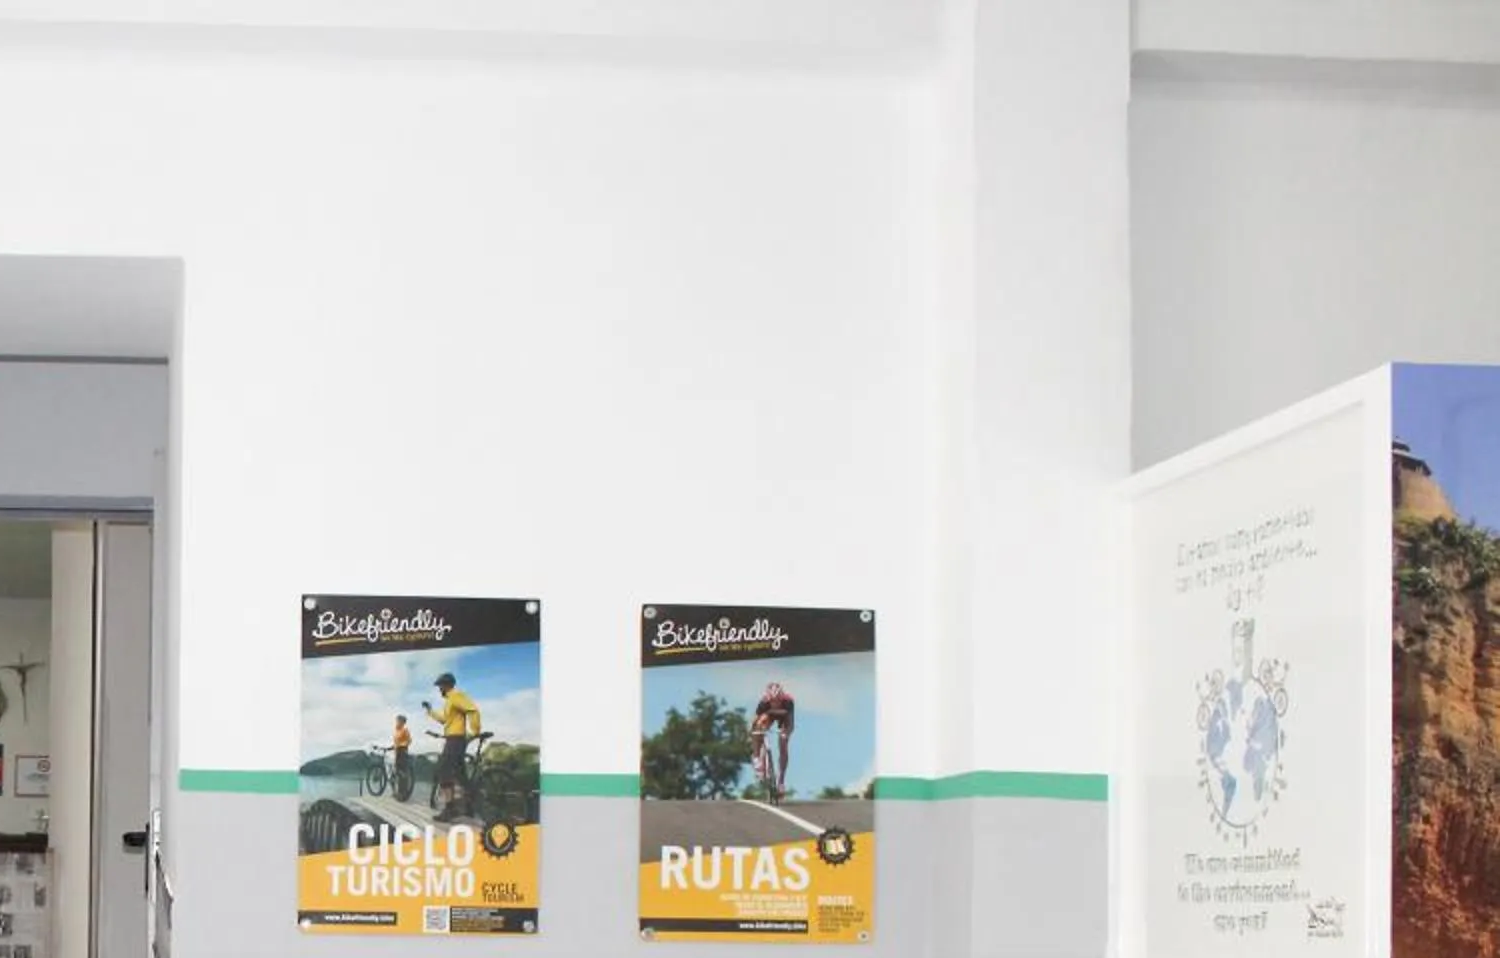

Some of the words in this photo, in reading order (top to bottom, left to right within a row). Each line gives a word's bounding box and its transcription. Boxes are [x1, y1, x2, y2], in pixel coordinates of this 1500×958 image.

[312, 607, 452, 643] Bikefriendly
[651, 617, 789, 652] Bikefriendly
[349, 823, 476, 866] CICLO
[326, 864, 477, 898] TURISMO
[660, 844, 811, 891] RUTAS
